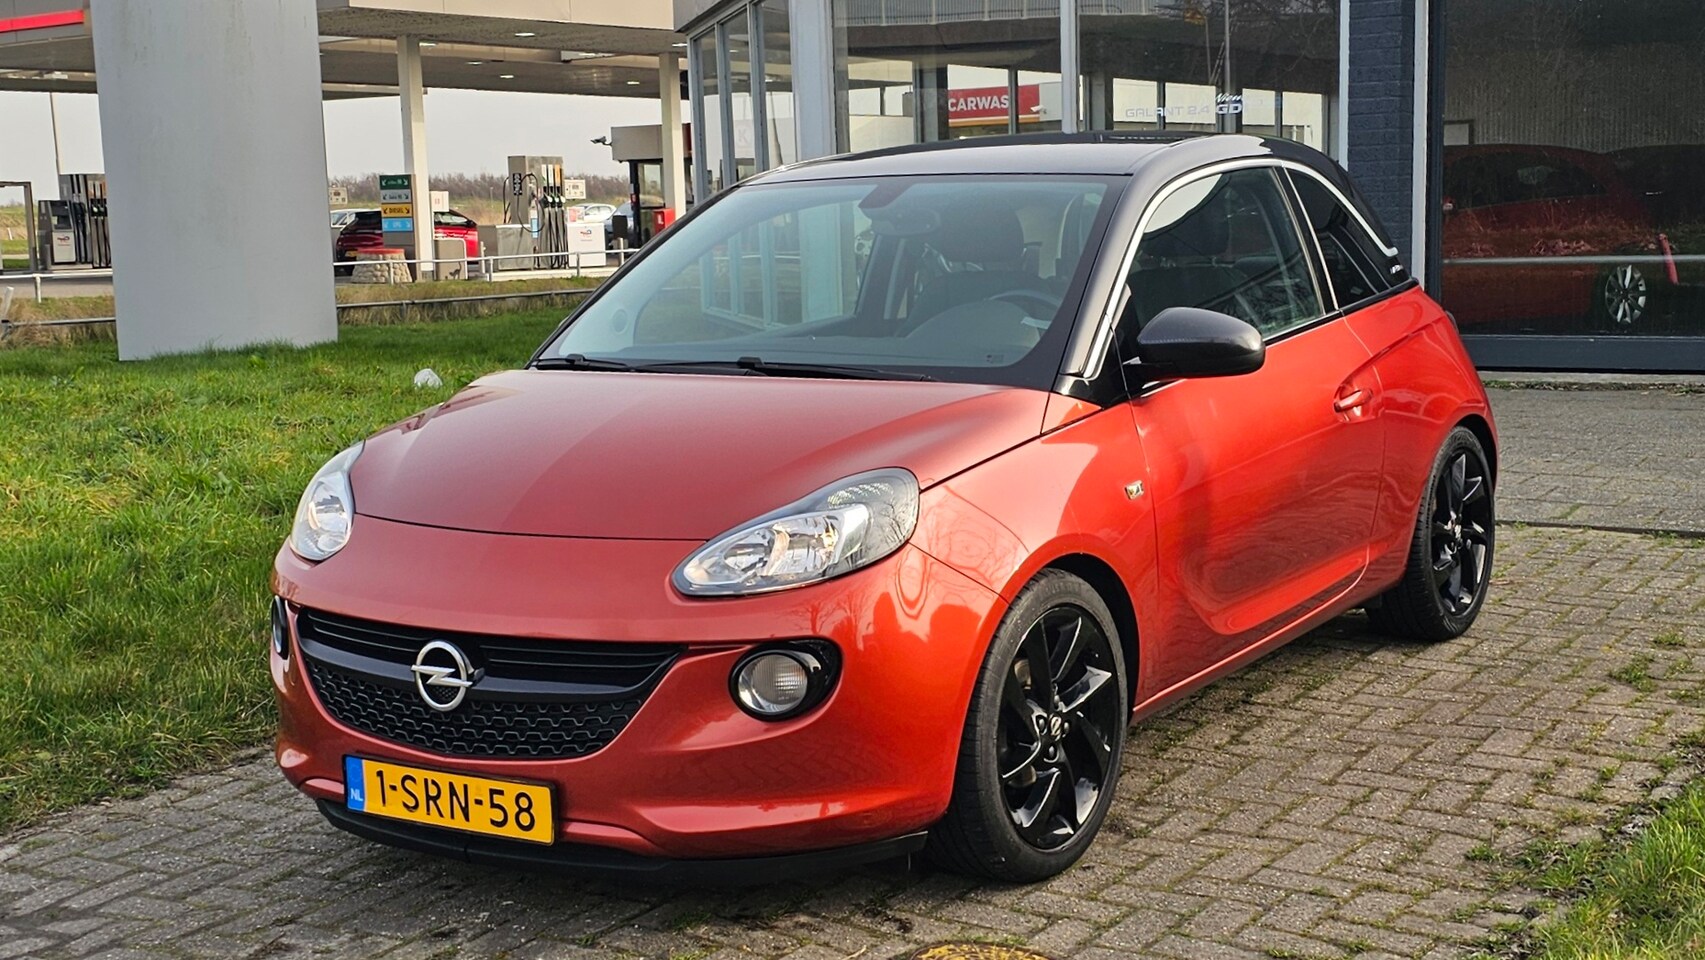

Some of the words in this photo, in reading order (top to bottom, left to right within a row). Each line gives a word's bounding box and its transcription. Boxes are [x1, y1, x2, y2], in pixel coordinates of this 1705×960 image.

[1125, 106, 1184, 118] GALANT
[1187, 105, 1210, 115] 2.4
[350, 787, 363, 801] NL
[375, 769, 536, 832] 1-SRN-58
